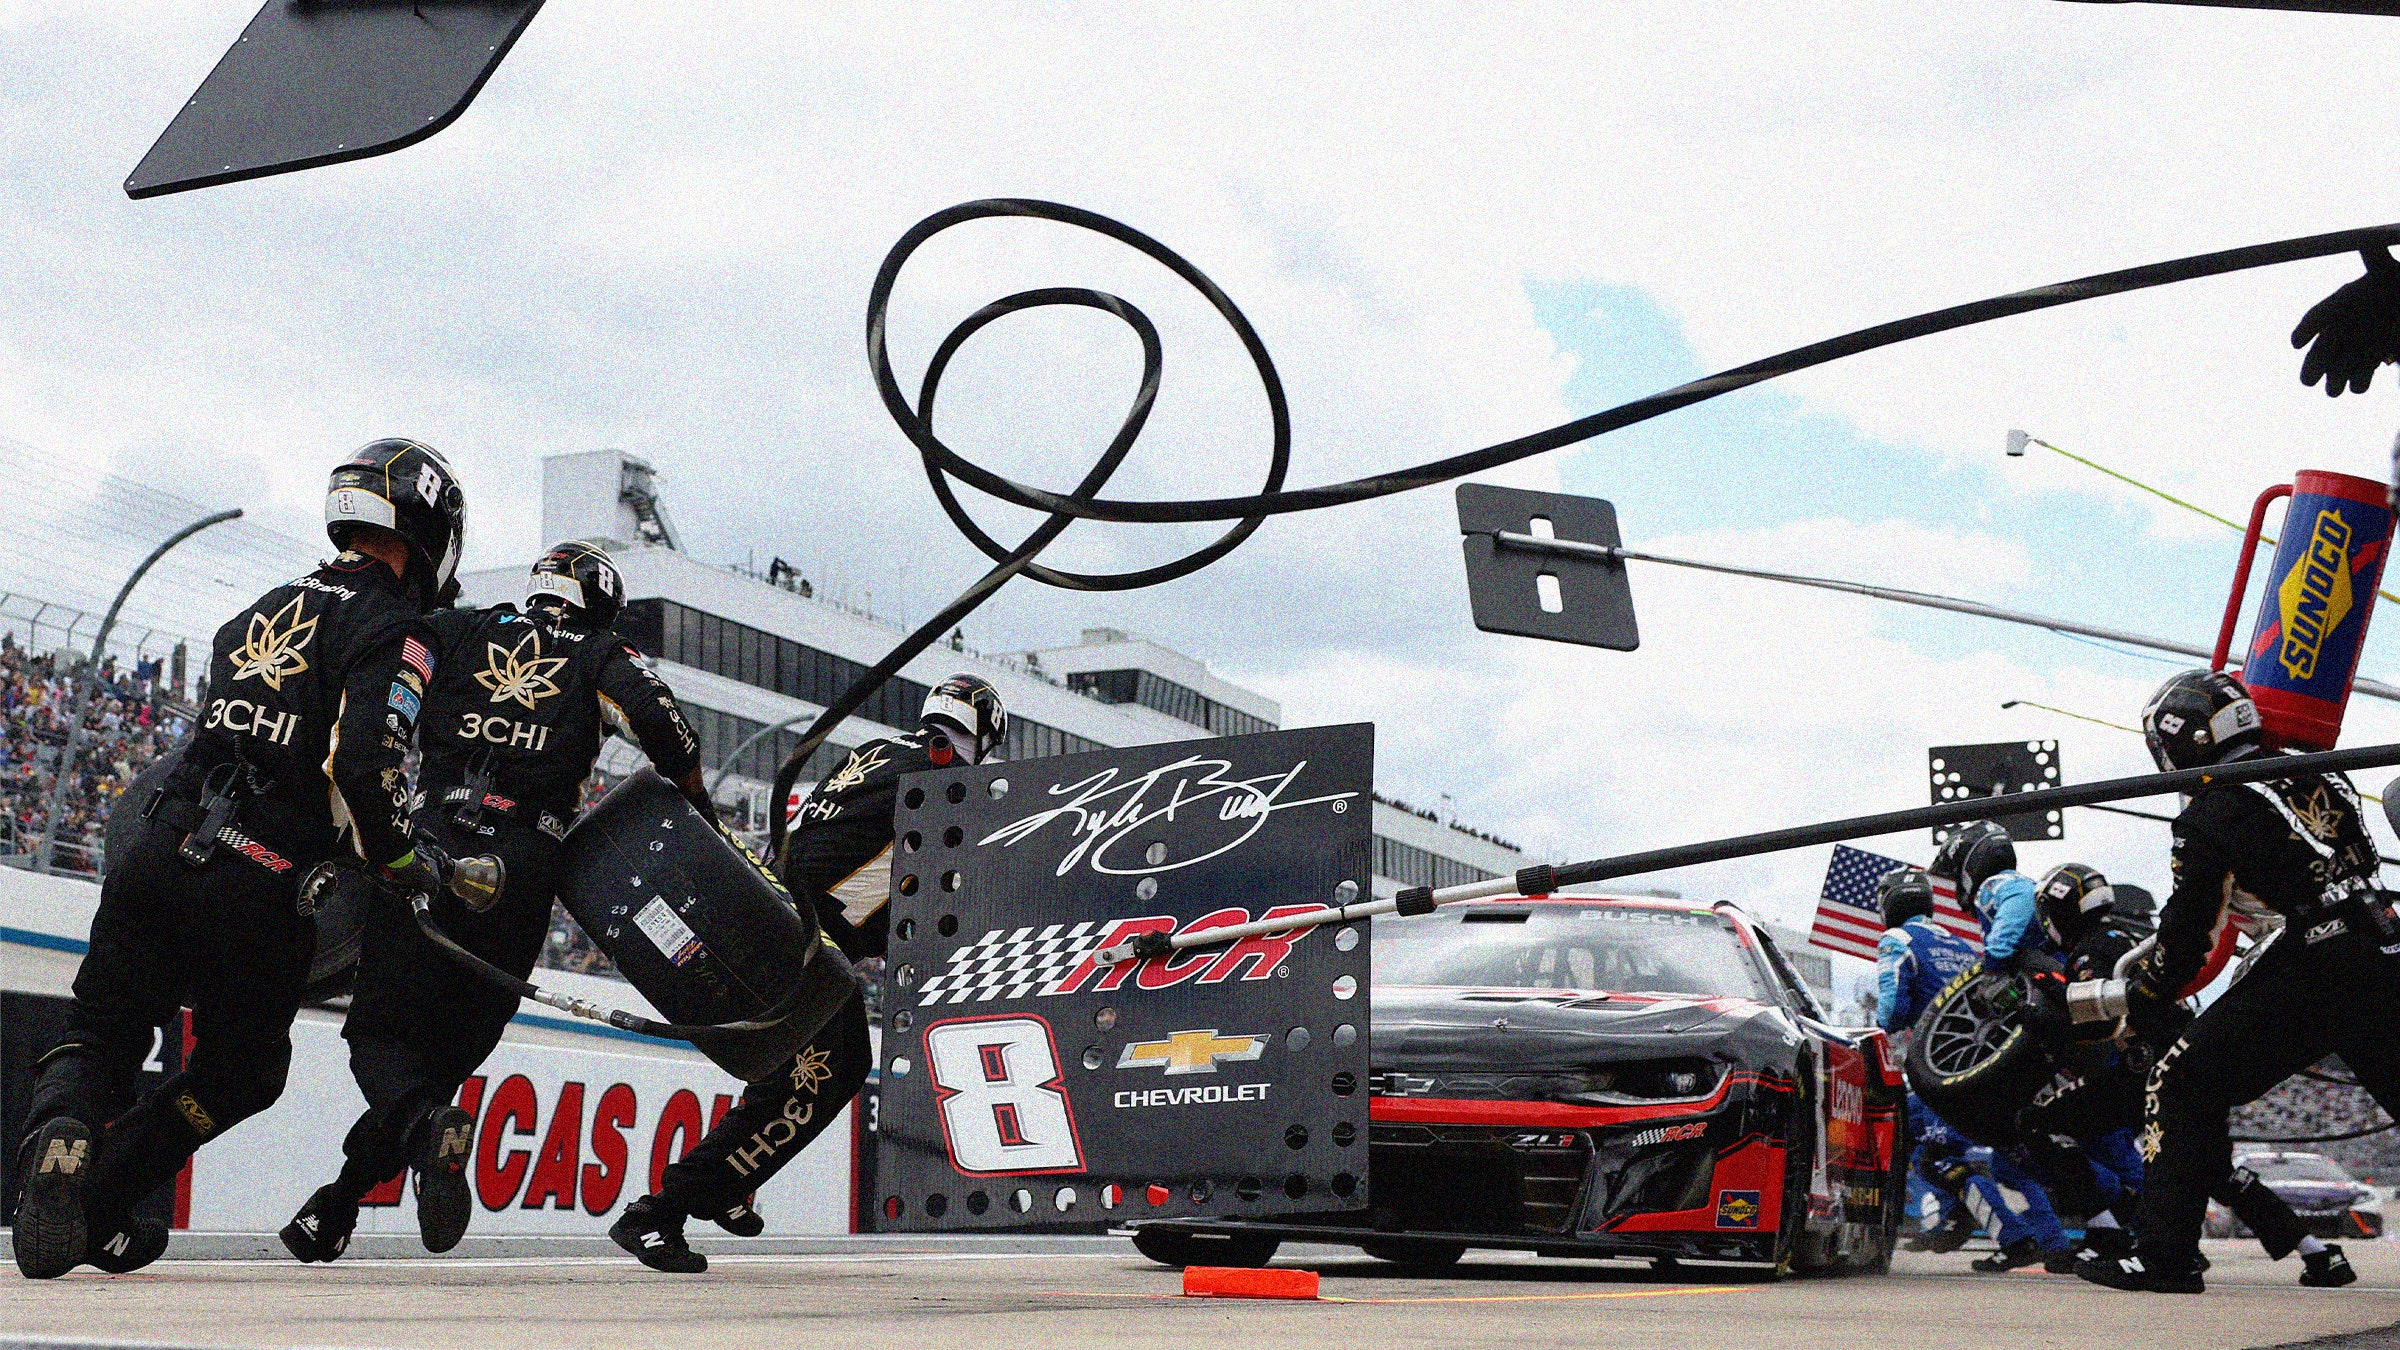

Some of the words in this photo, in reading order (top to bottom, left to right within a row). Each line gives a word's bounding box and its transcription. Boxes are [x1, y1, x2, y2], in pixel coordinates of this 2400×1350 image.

[416, 462, 442, 509] 8
[338, 490, 355, 514] 8
[540, 571, 554, 590] 8
[598, 563, 614, 597] 8
[2284, 516, 2348, 674] SUNOCO
[205, 699, 298, 746] 3CHI
[458, 713, 549, 751] 3CHI
[668, 706, 698, 754] 3CHI
[2159, 713, 2185, 735] 8
[237, 843, 292, 871] RCR
[1580, 910, 1698, 926] BUSCH
[1056, 903, 1330, 995] RCR
[1934, 963, 1982, 1008] EAGLE
[922, 1011, 1087, 1178] 8
[1114, 1083, 1271, 1108] CHEVROLET
[361, 1074, 637, 1217] CAS
[725, 1096, 814, 1177] 3CHI
[1512, 1133, 1574, 1147] ZL1
[1660, 1121, 1708, 1143] RCR
[1719, 1204, 1758, 1216] SUNOCO
[640, 1231, 664, 1249] N
[2118, 1256, 2145, 1274] N
